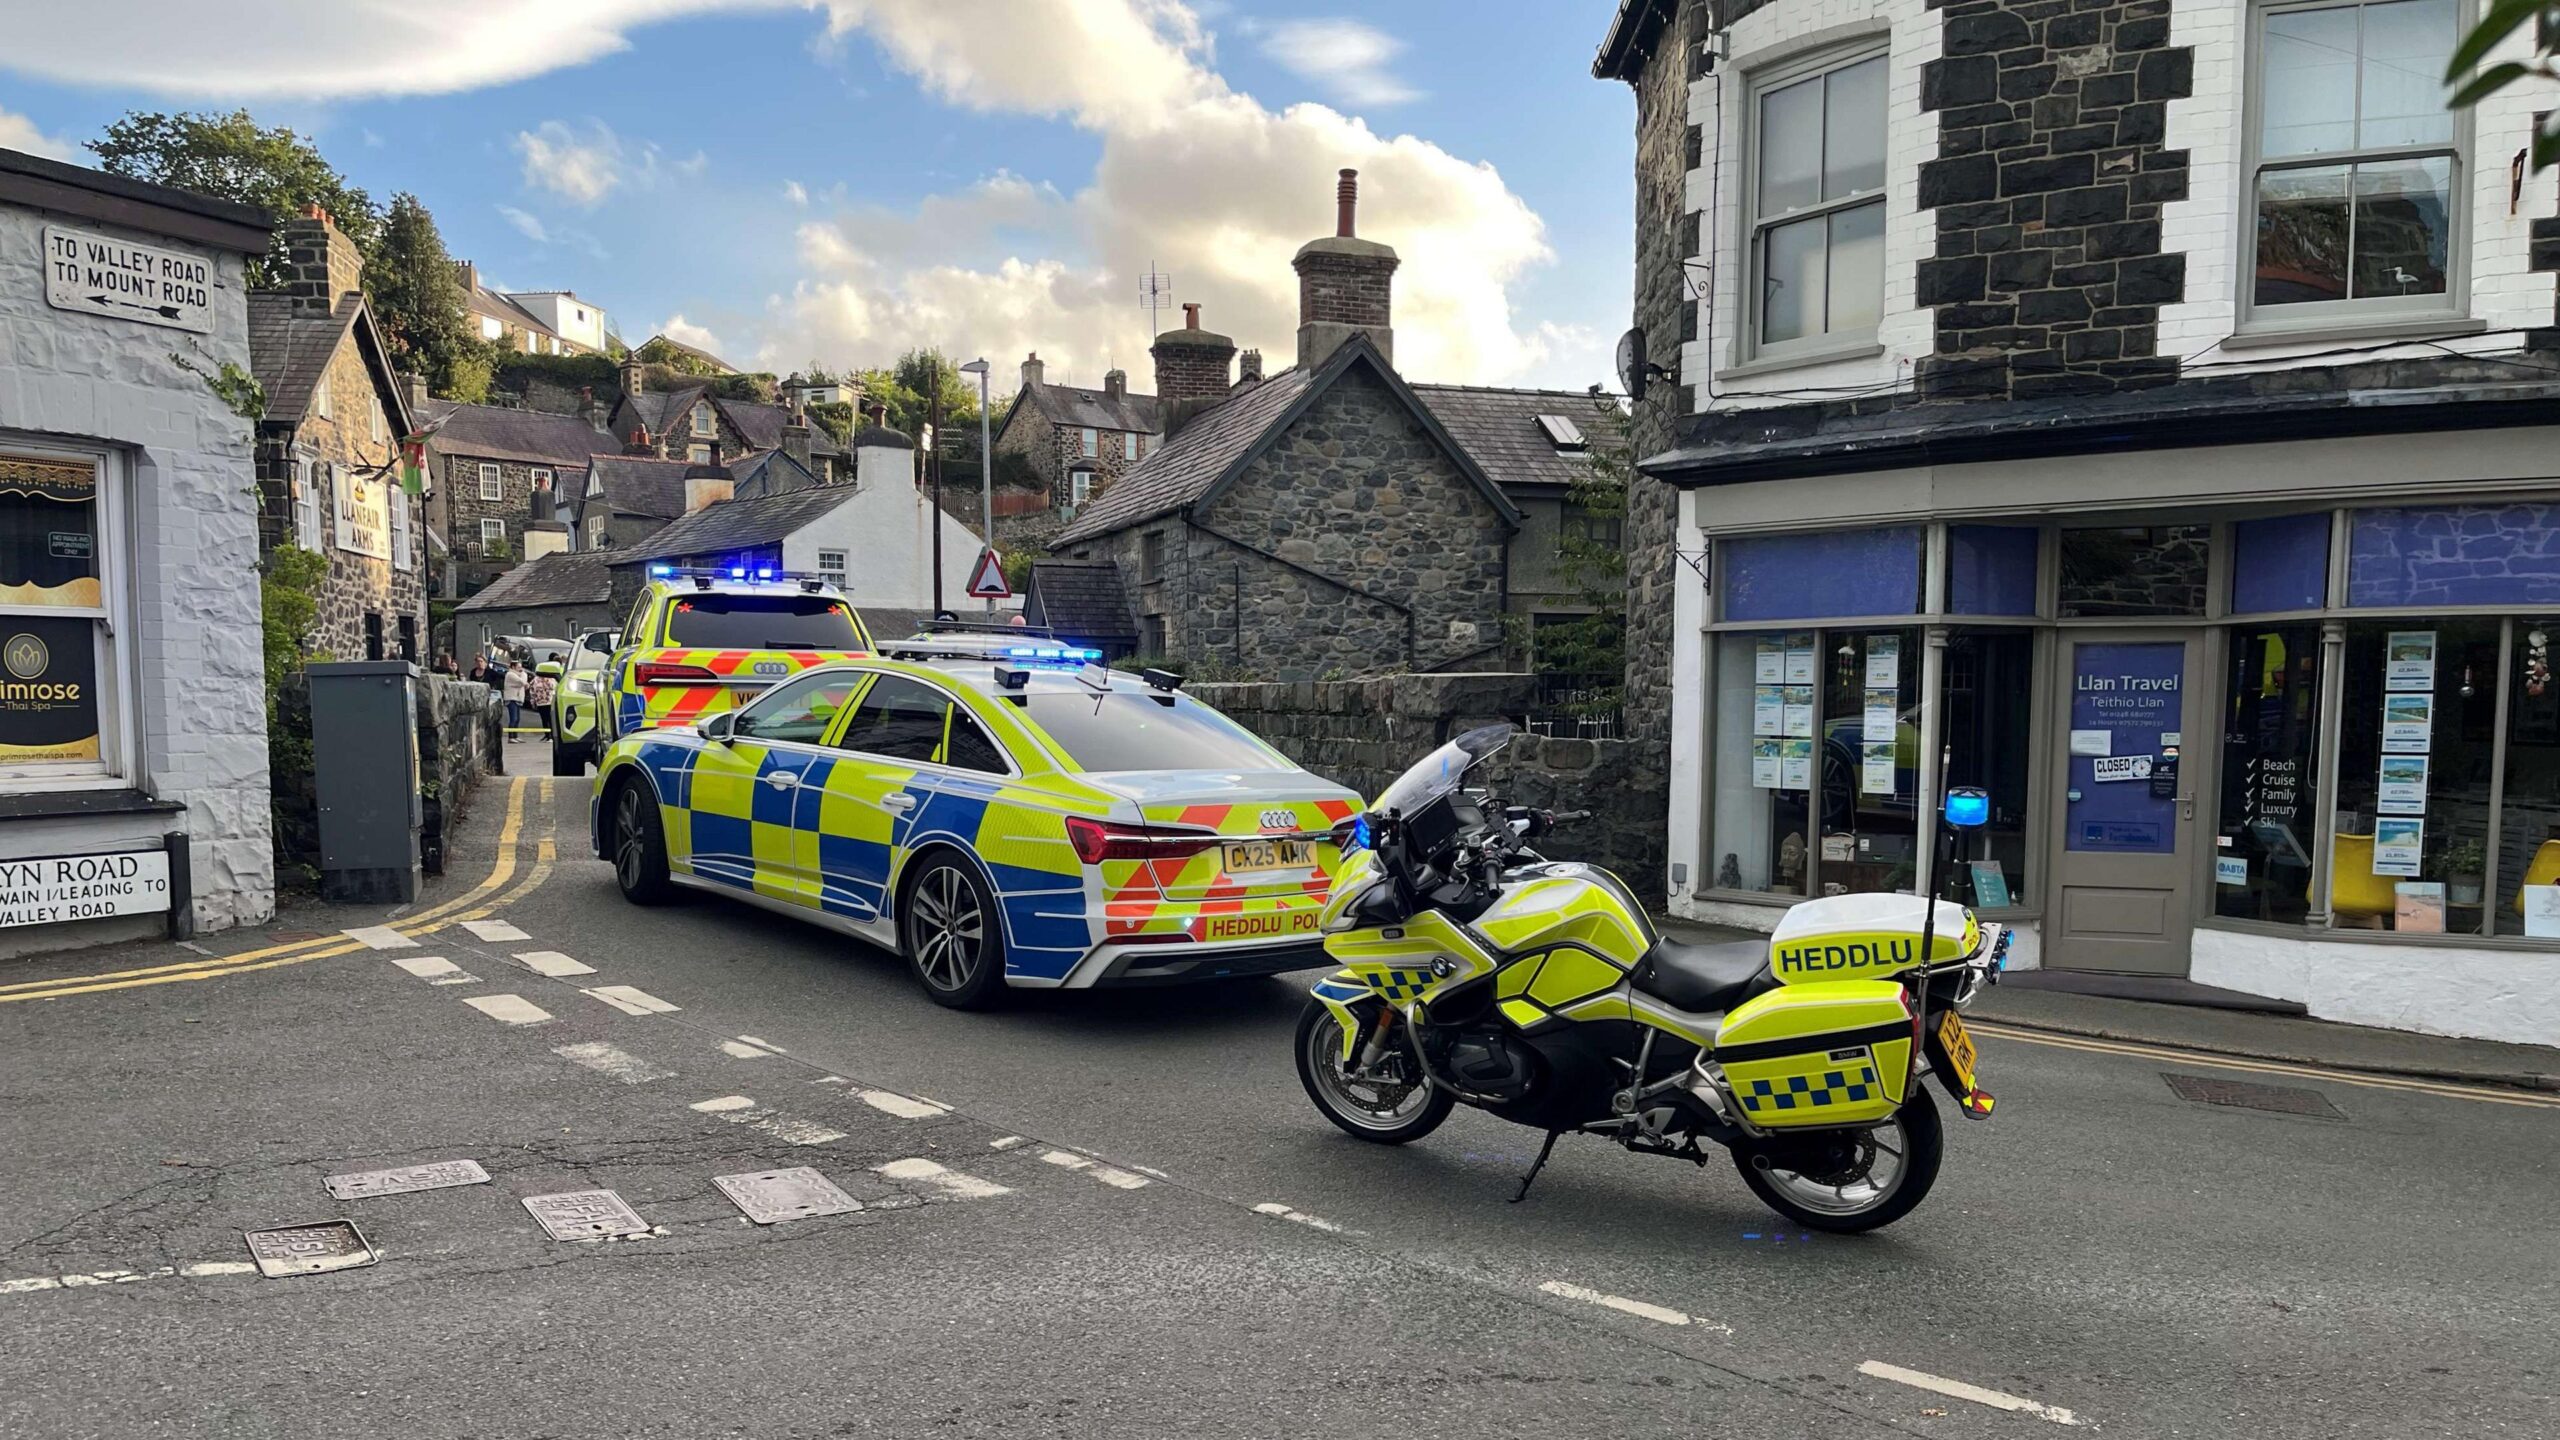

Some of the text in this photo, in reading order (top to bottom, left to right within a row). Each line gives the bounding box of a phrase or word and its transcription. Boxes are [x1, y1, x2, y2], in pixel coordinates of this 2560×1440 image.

[54, 236, 205, 284] TO VALLEY ROAD
[54, 261, 206, 307] TO MOUNT ROAD
[341, 499, 381, 531] LLANFAIR
[351, 528, 374, 551] ARMS
[2078, 674, 2178, 690] Llan Travel
[6, 701, 52, 712] Thai Spa
[2090, 696, 2165, 708] Teithio Llan
[2096, 758, 2131, 773] CLOSED
[2263, 759, 2296, 771] Beach
[2262, 773, 2296, 786] Cruise
[2261, 788, 2296, 804] Family
[2260, 802, 2298, 818] Luxury
[2260, 816, 2276, 828] Ski
[1231, 845, 1275, 868] CX25
[0, 856, 138, 888] YN ROAD
[145, 879, 166, 892] TO
[70, 902, 115, 918] ROAD
[1213, 916, 1281, 937] HEDDLU
[1781, 939, 1912, 972] HEDDLU
[1955, 1035, 1973, 1074] VRK
